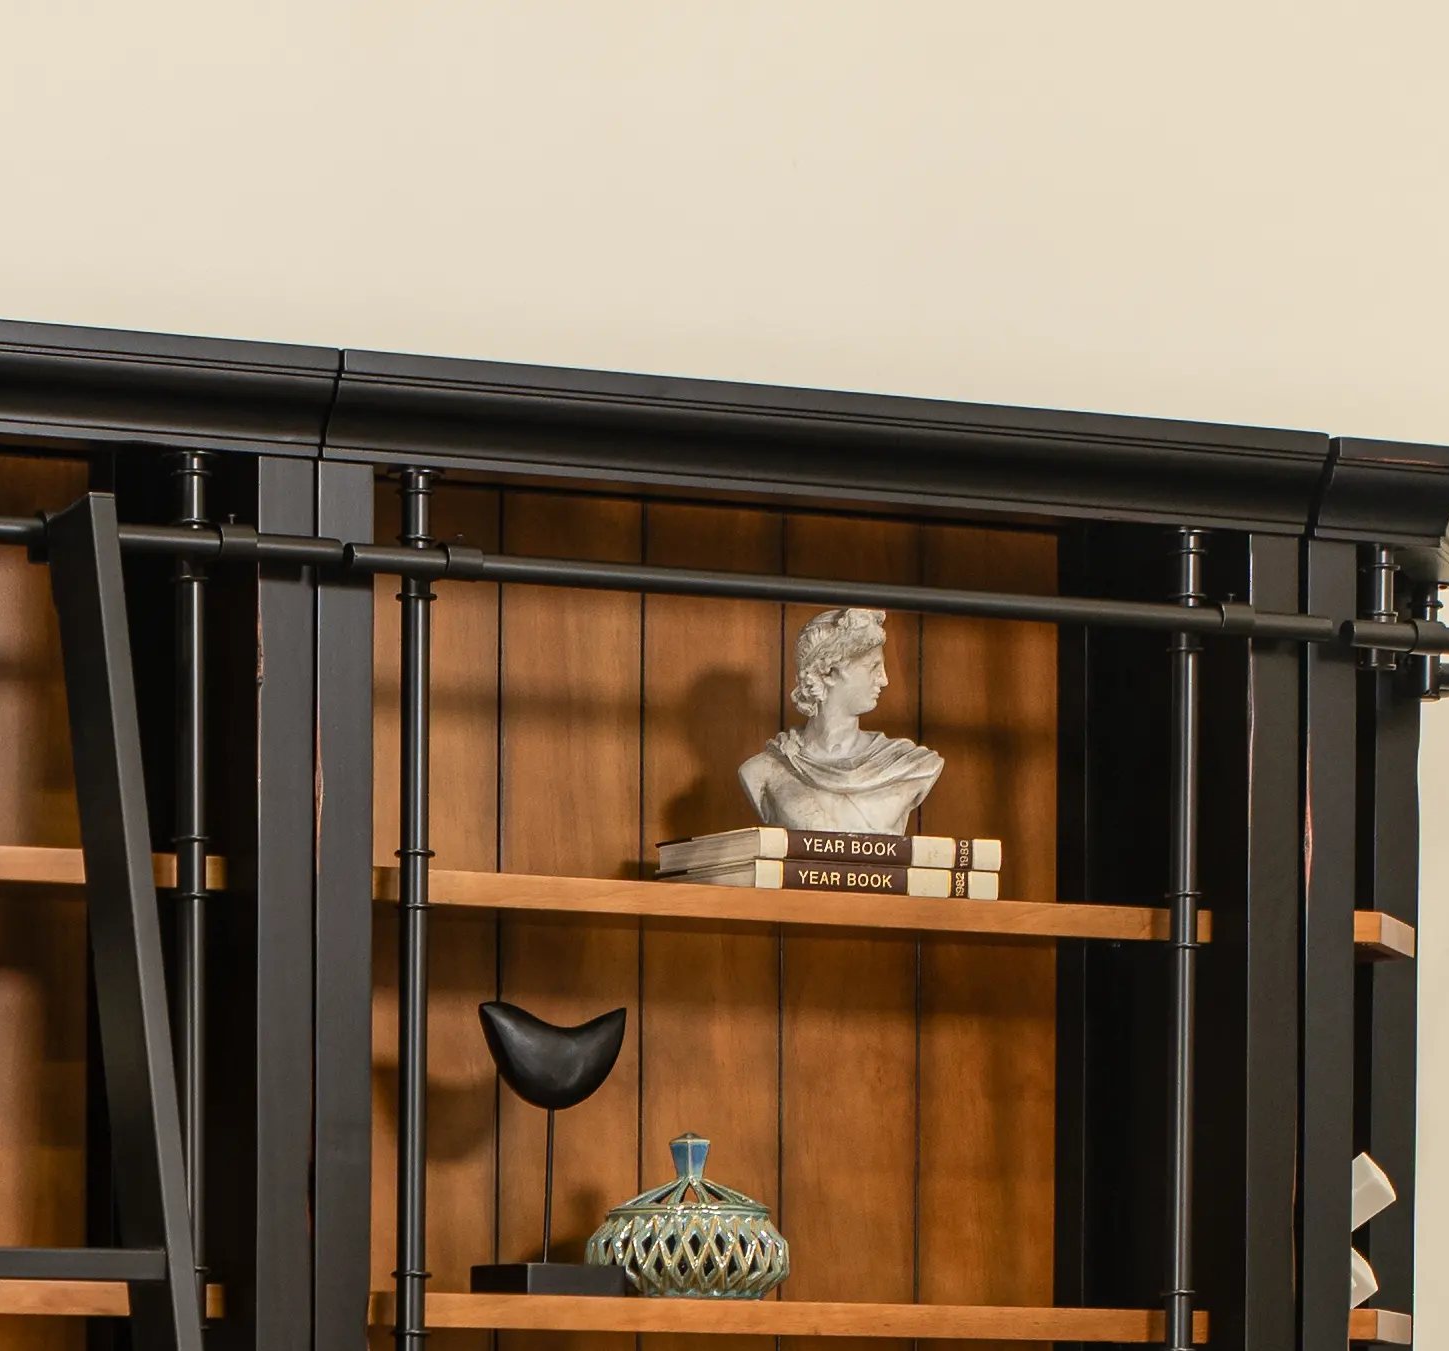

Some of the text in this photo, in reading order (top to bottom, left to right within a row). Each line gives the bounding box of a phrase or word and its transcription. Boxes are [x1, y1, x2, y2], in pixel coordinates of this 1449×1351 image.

[803, 837, 897, 857] YEAR BOOK
[959, 840, 969, 867] 1980
[798, 870, 892, 888] YEAR BOOK
[955, 872, 965, 897] 1982
